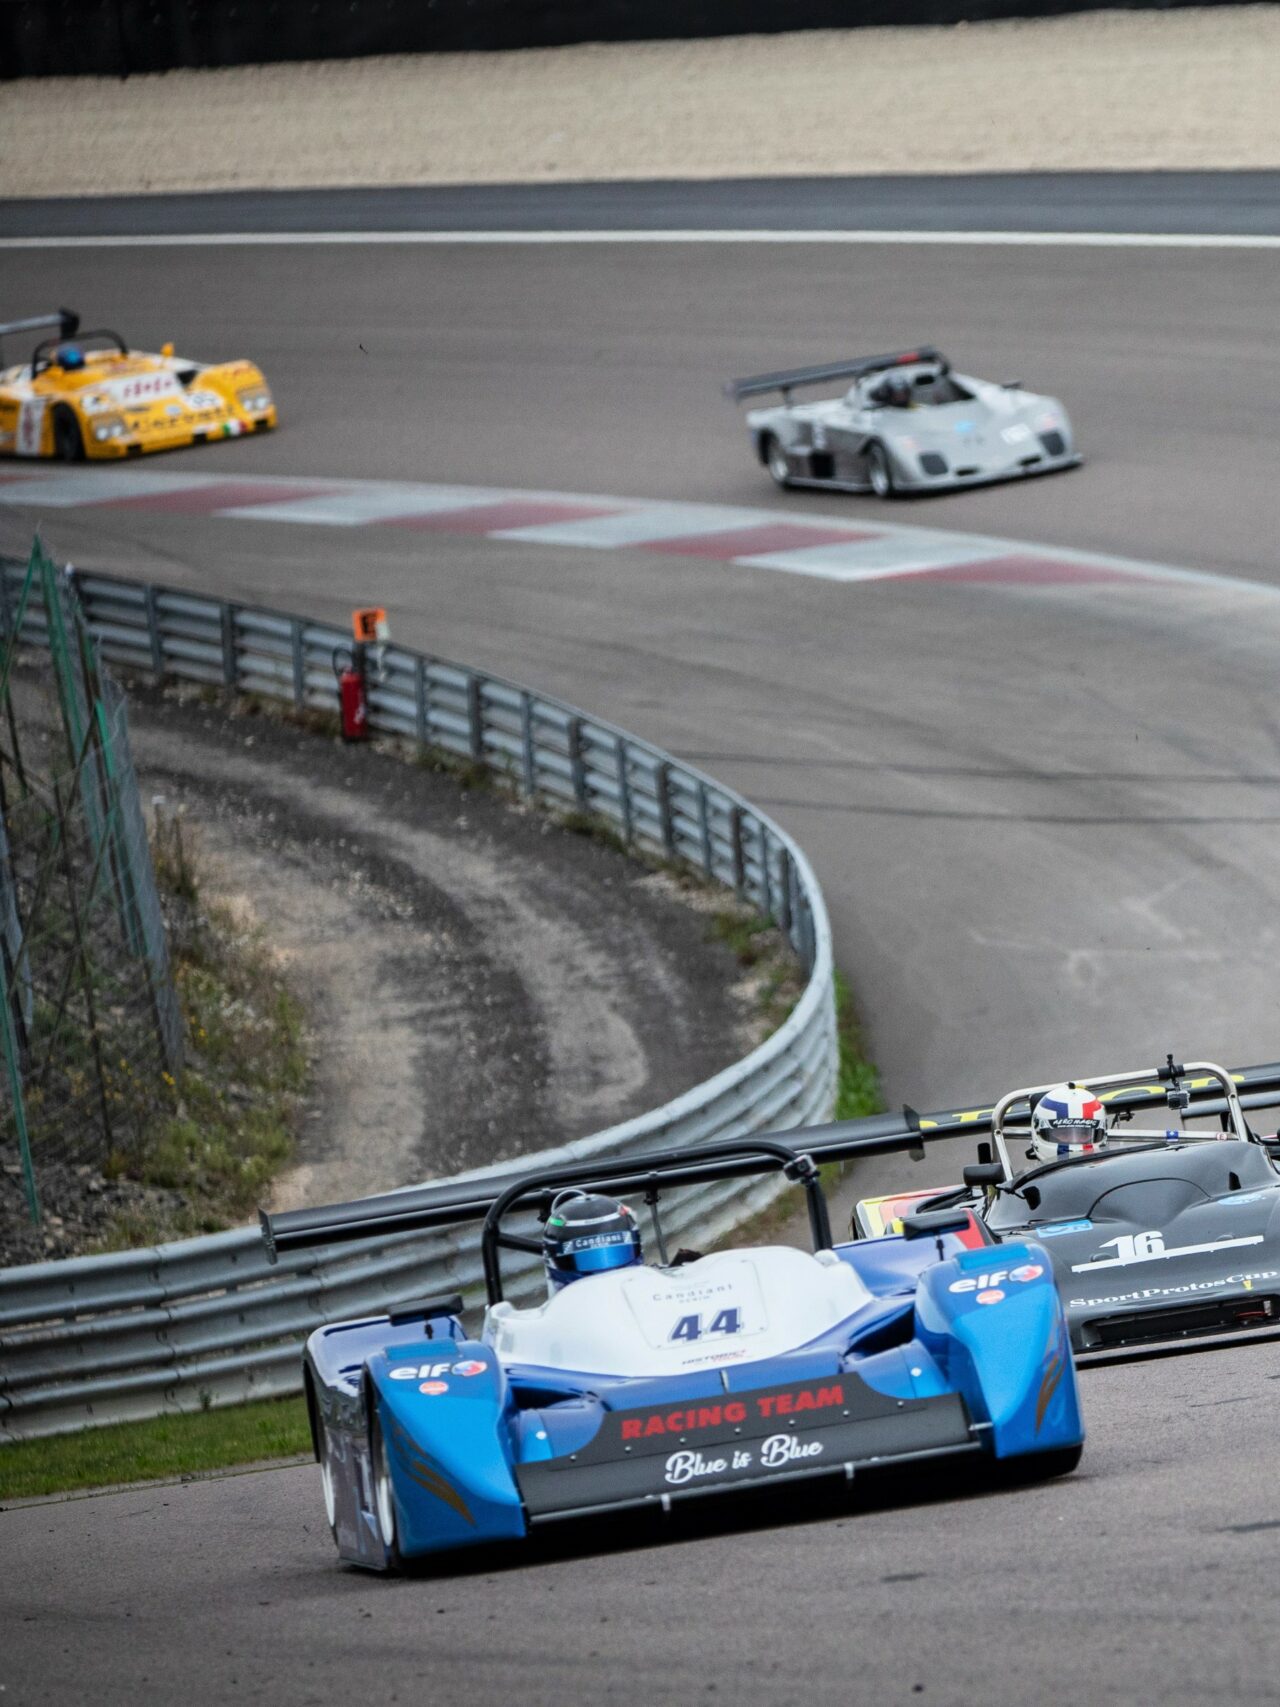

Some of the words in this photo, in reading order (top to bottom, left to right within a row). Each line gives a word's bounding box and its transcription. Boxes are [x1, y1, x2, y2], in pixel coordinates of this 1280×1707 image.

[575, 1233, 622, 1248] Candiani
[1099, 1230, 1166, 1259] 16
[653, 1283, 733, 1302] Candiani
[949, 1271, 1009, 1293] elf
[1070, 1270, 1279, 1308] SportProtosCup
[669, 1306, 743, 1342] 44
[389, 1363, 451, 1380] elf
[621, 1401, 747, 1440] RACING
[757, 1385, 844, 1418] TEAM
[665, 1450, 727, 1484] Blue
[732, 1450, 752, 1470] is
[760, 1434, 824, 1467] Blue
